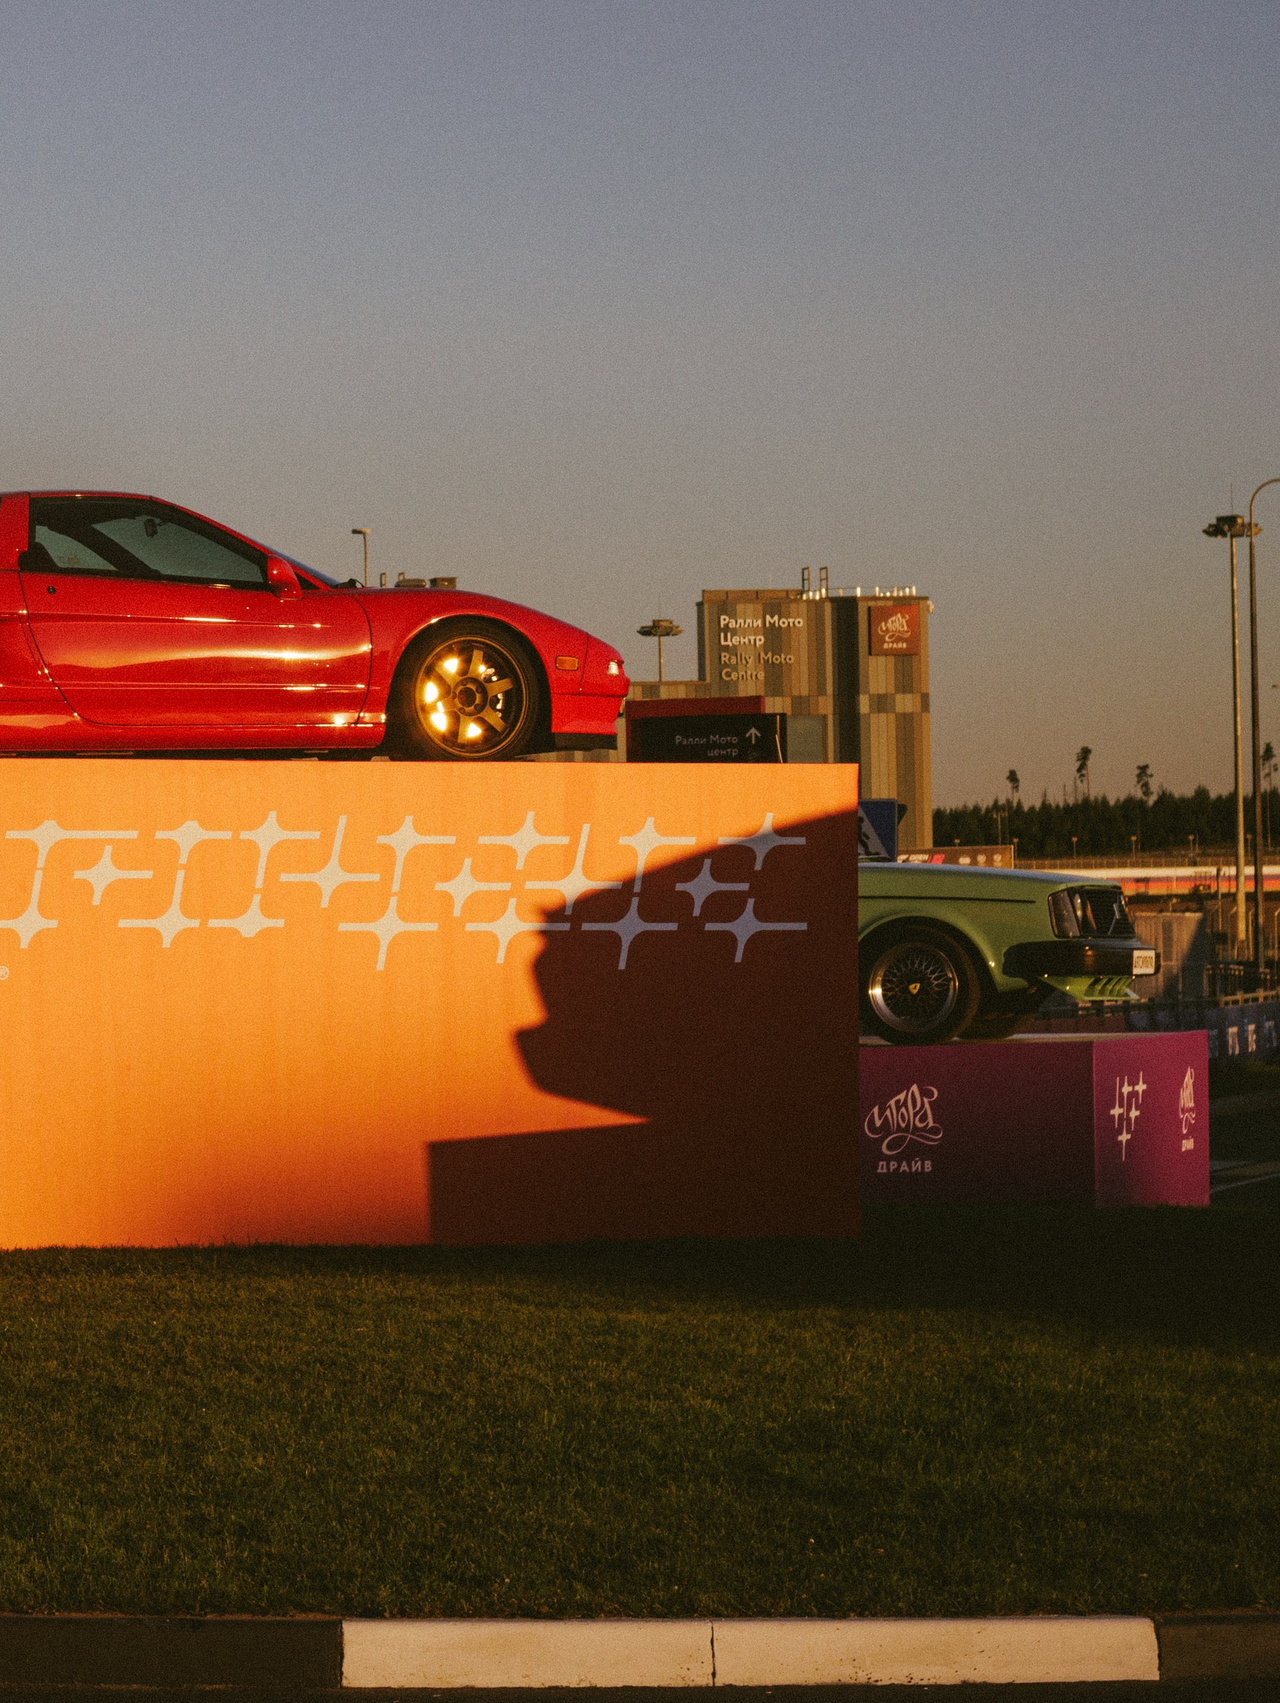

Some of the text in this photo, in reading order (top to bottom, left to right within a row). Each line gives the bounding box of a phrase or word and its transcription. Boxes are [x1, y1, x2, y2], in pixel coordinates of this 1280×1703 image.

[720, 614, 804, 628] Ралли Мото
[720, 632, 765, 647] Центр
[720, 651, 795, 667] Rally Moto
[721, 668, 765, 681] Centre
[675, 735, 738, 745] Ралли Мото
[707, 748, 739, 757] центр
[876, 1157, 933, 1174] ДРАЙВ
